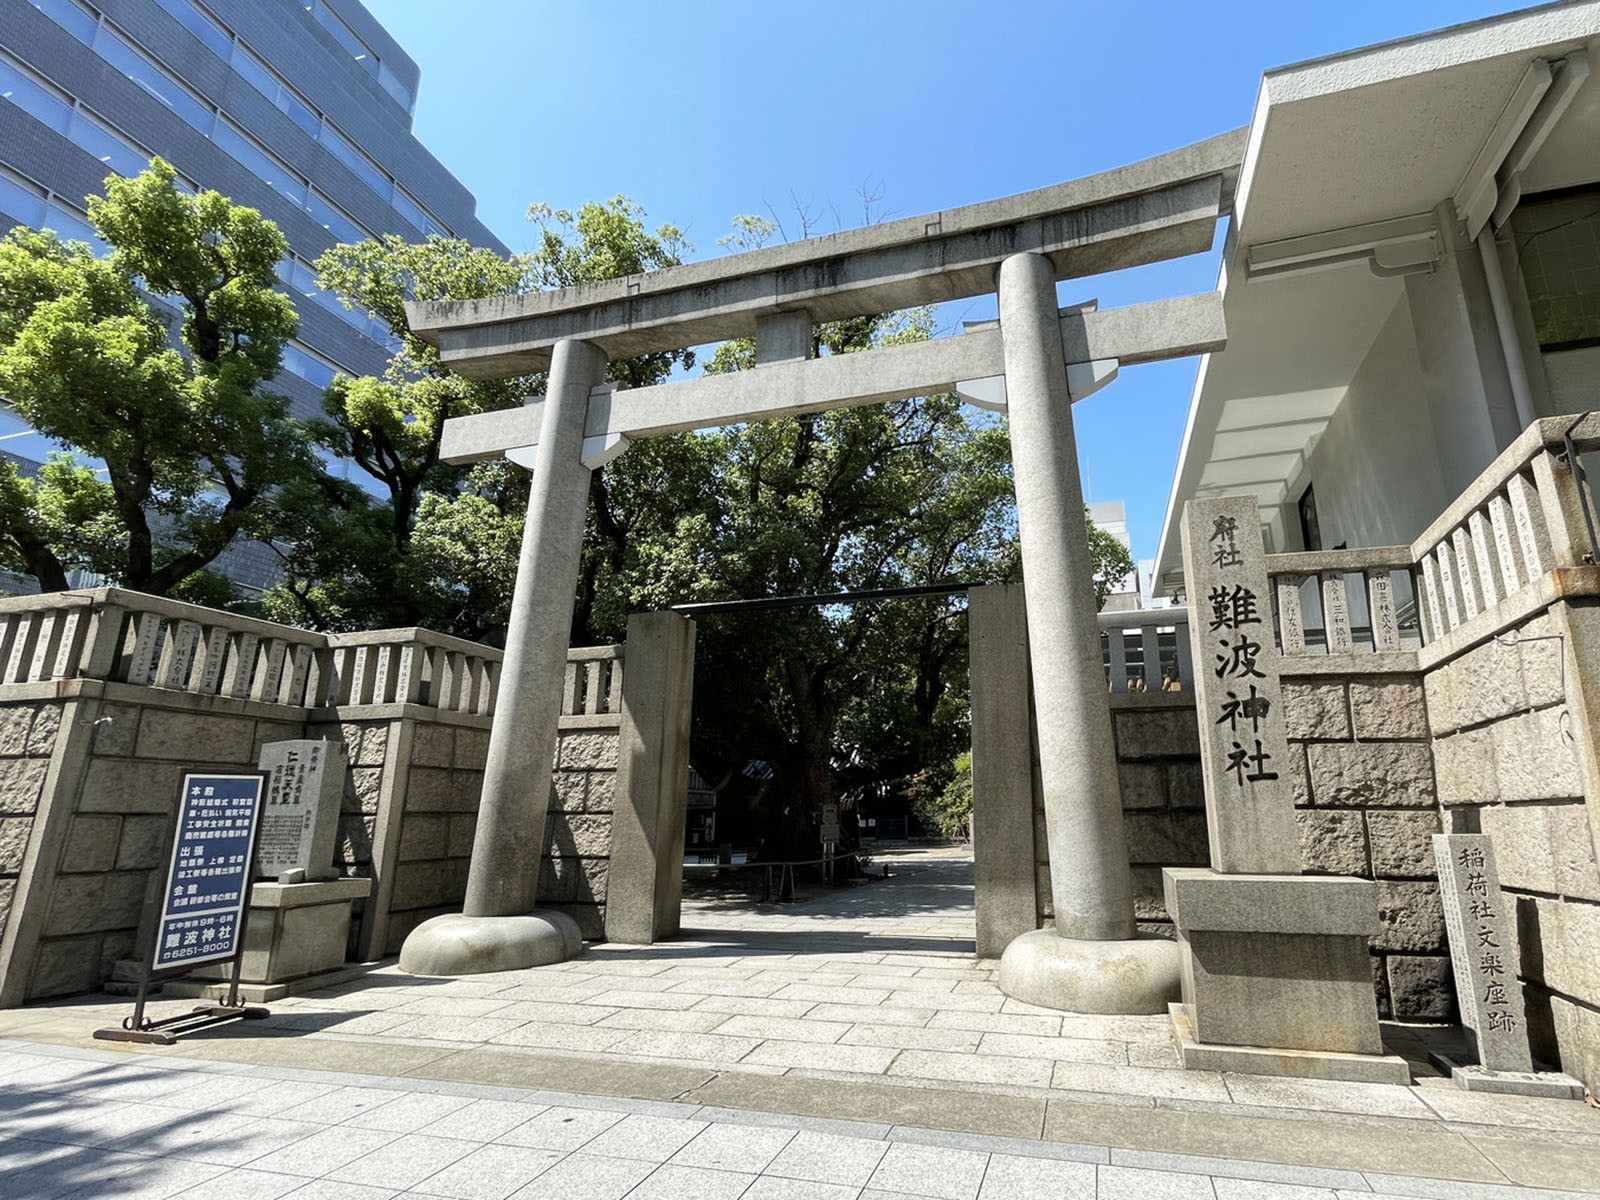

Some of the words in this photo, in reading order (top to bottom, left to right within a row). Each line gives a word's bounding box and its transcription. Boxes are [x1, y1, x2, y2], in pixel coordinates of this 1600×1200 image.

[1208, 583, 1279, 787] 難波神社
[180, 845, 204, 857] 出張
[173, 883, 198, 896] 会館
[165, 925, 231, 949] 難波神社
[1456, 847, 1516, 1033] 稲荷社文楽座跡
